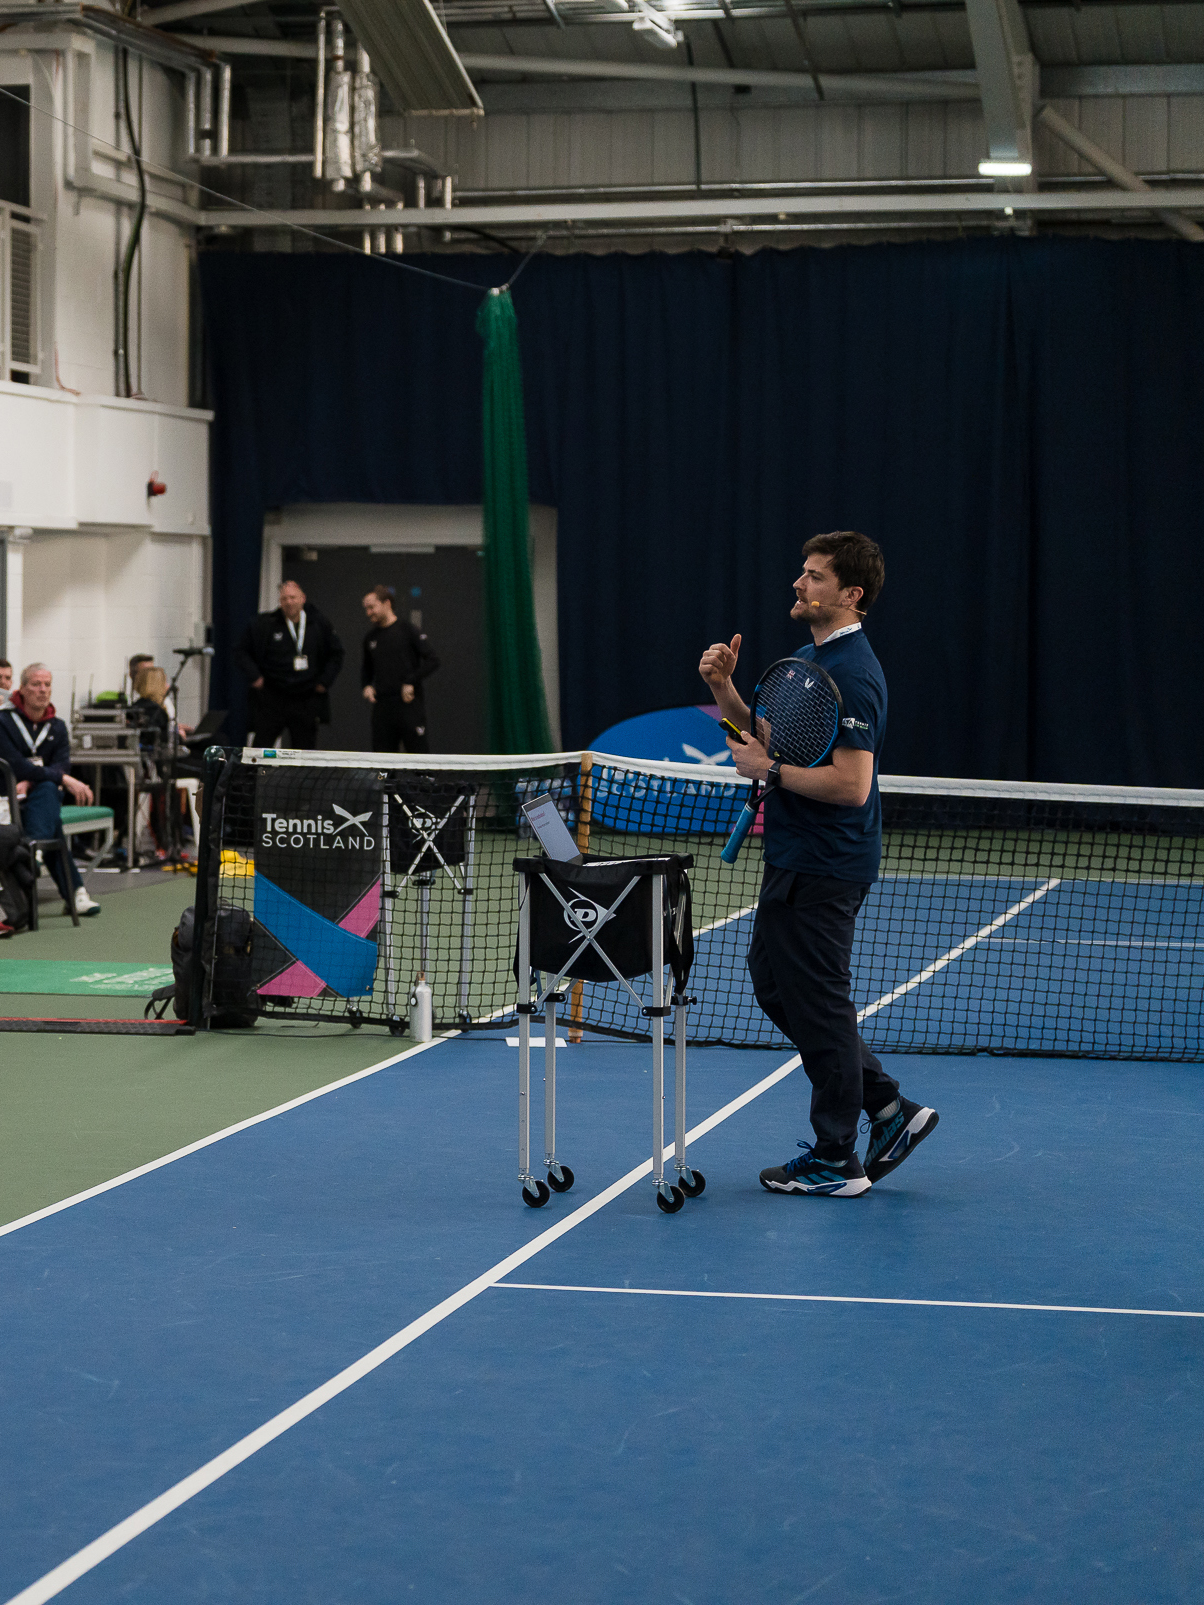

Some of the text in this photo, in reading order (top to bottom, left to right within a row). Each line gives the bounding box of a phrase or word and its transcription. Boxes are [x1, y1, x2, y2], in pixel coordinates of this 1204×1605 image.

[596, 780, 736, 798] SCOTLAND
[262, 813, 335, 833] Tennis
[262, 833, 375, 850] SCOTLAND
[864, 1111, 905, 1168] adidas
